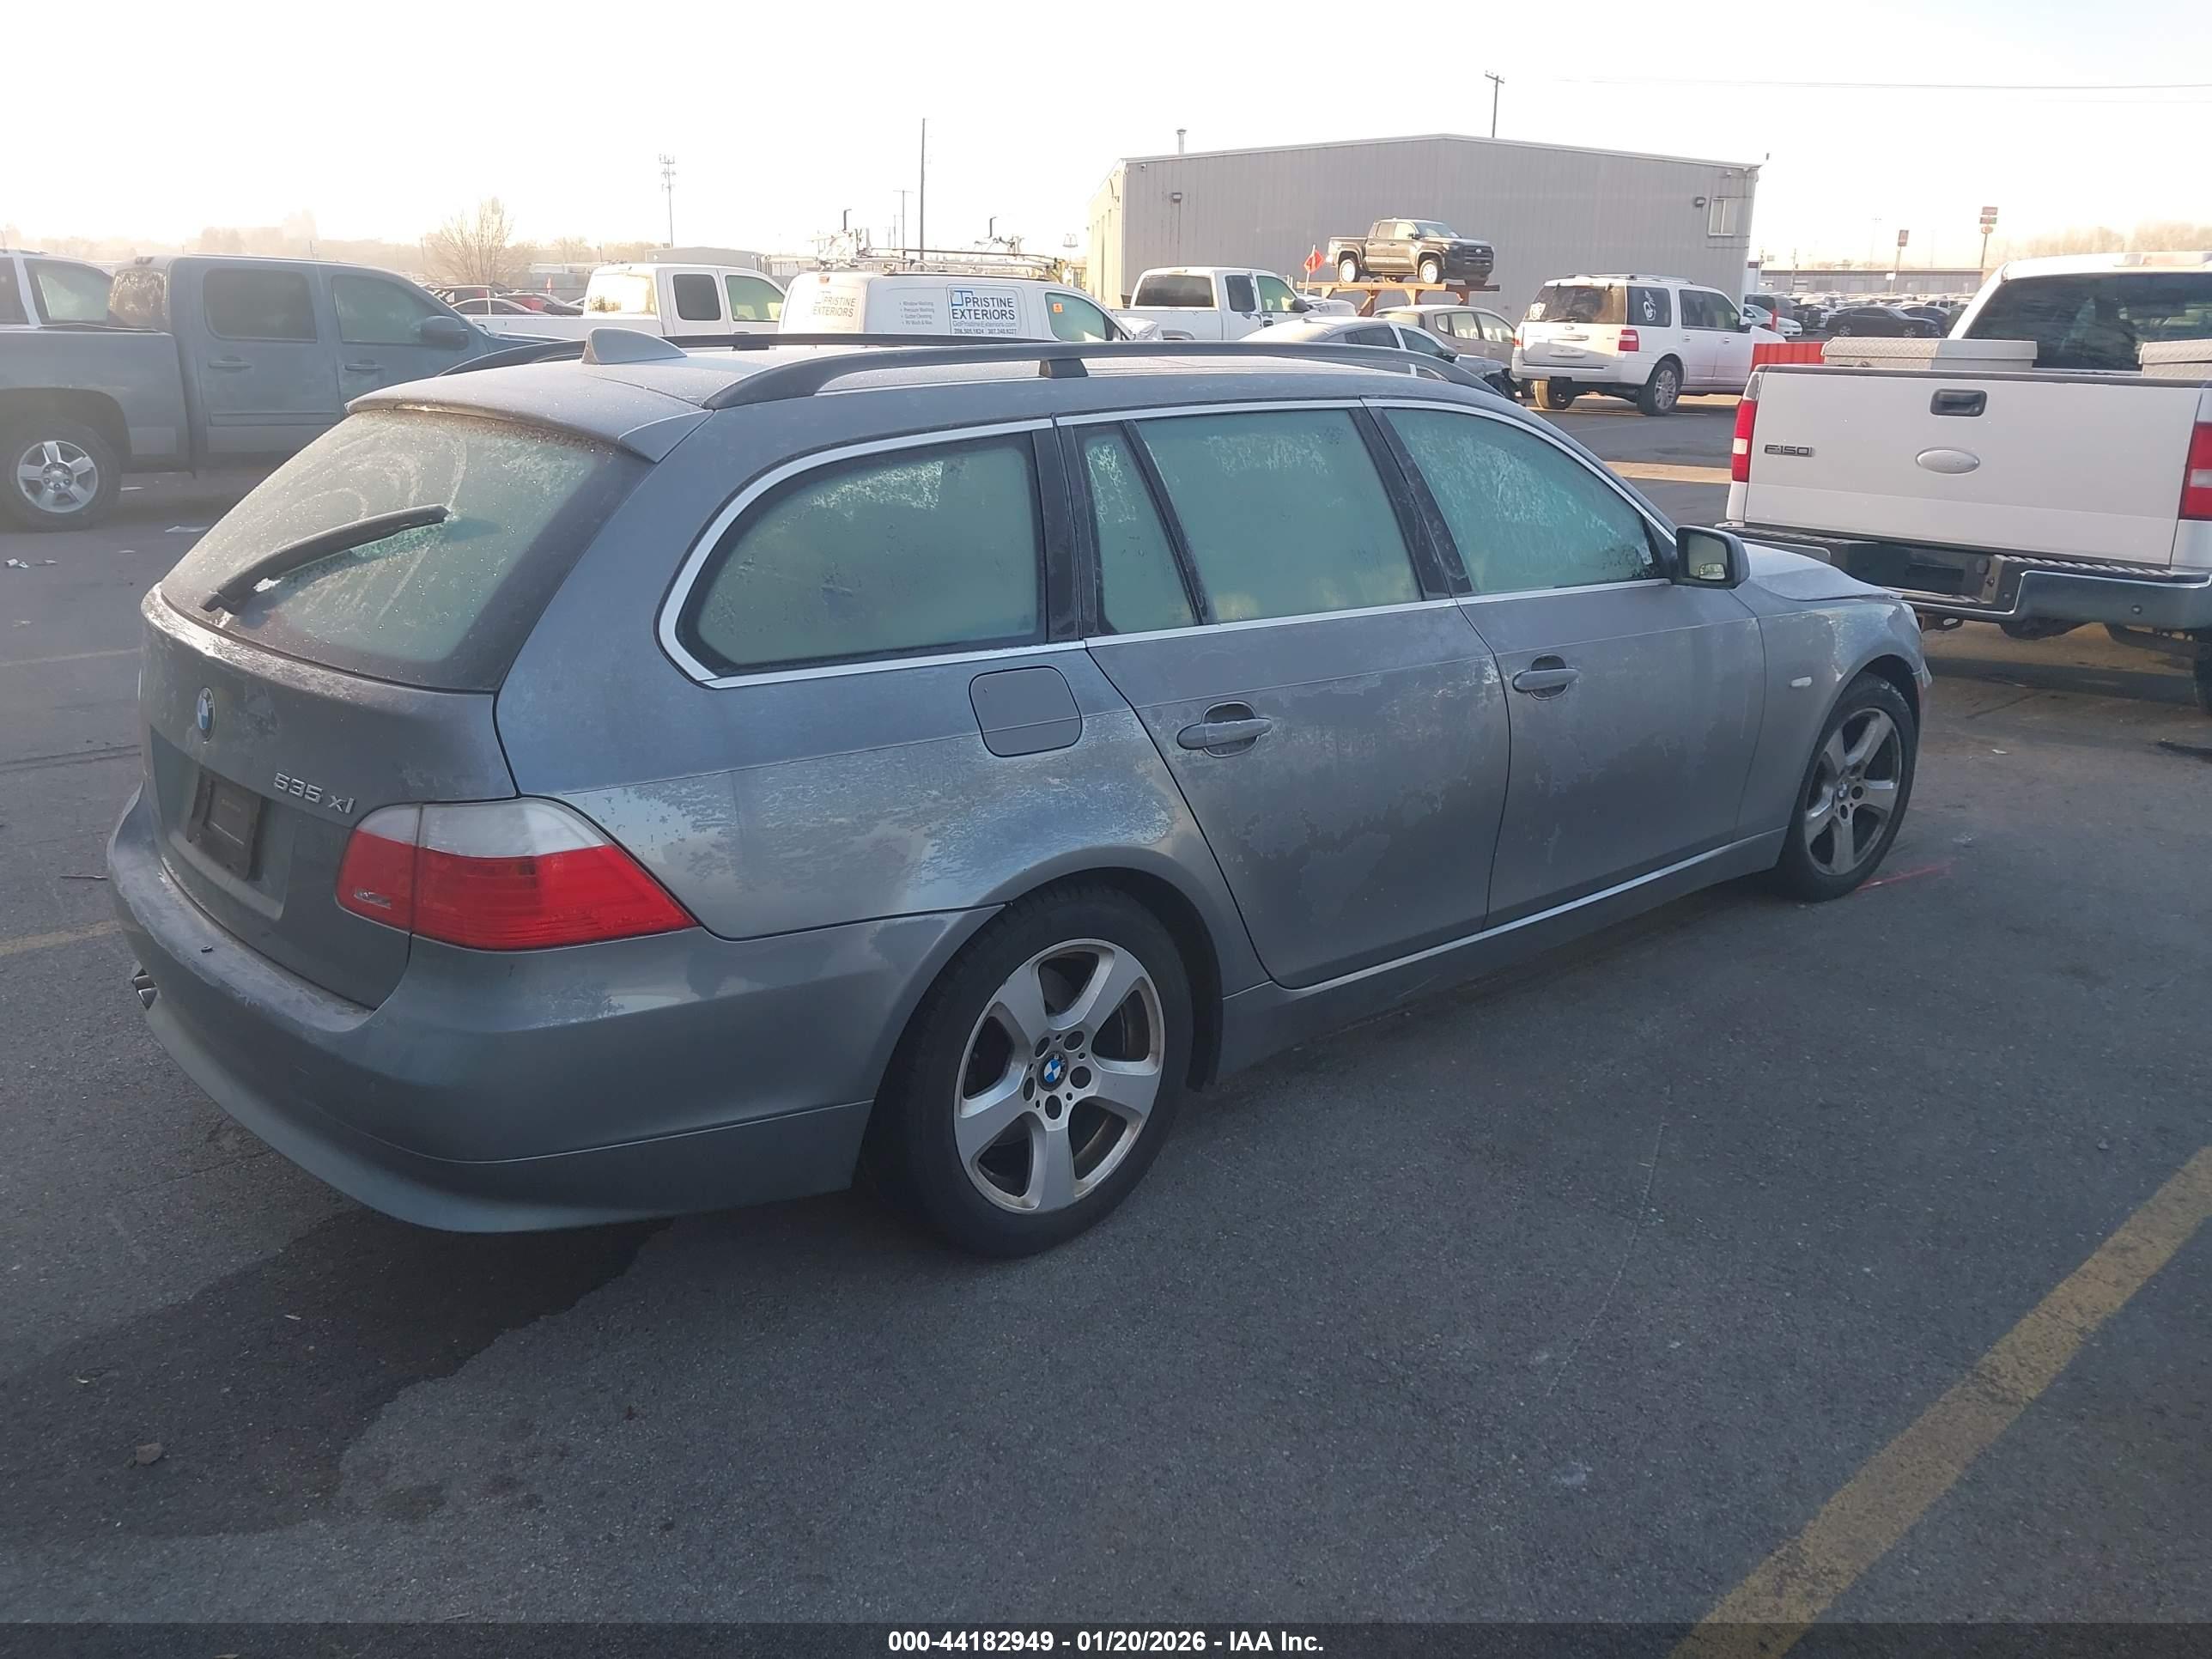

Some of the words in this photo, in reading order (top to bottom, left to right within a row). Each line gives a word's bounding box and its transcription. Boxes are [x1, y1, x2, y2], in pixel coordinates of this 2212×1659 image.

[964, 296, 1015, 308] PRISTINE
[951, 308, 1016, 320] EXTERIORS
[274, 772, 324, 804] 535
